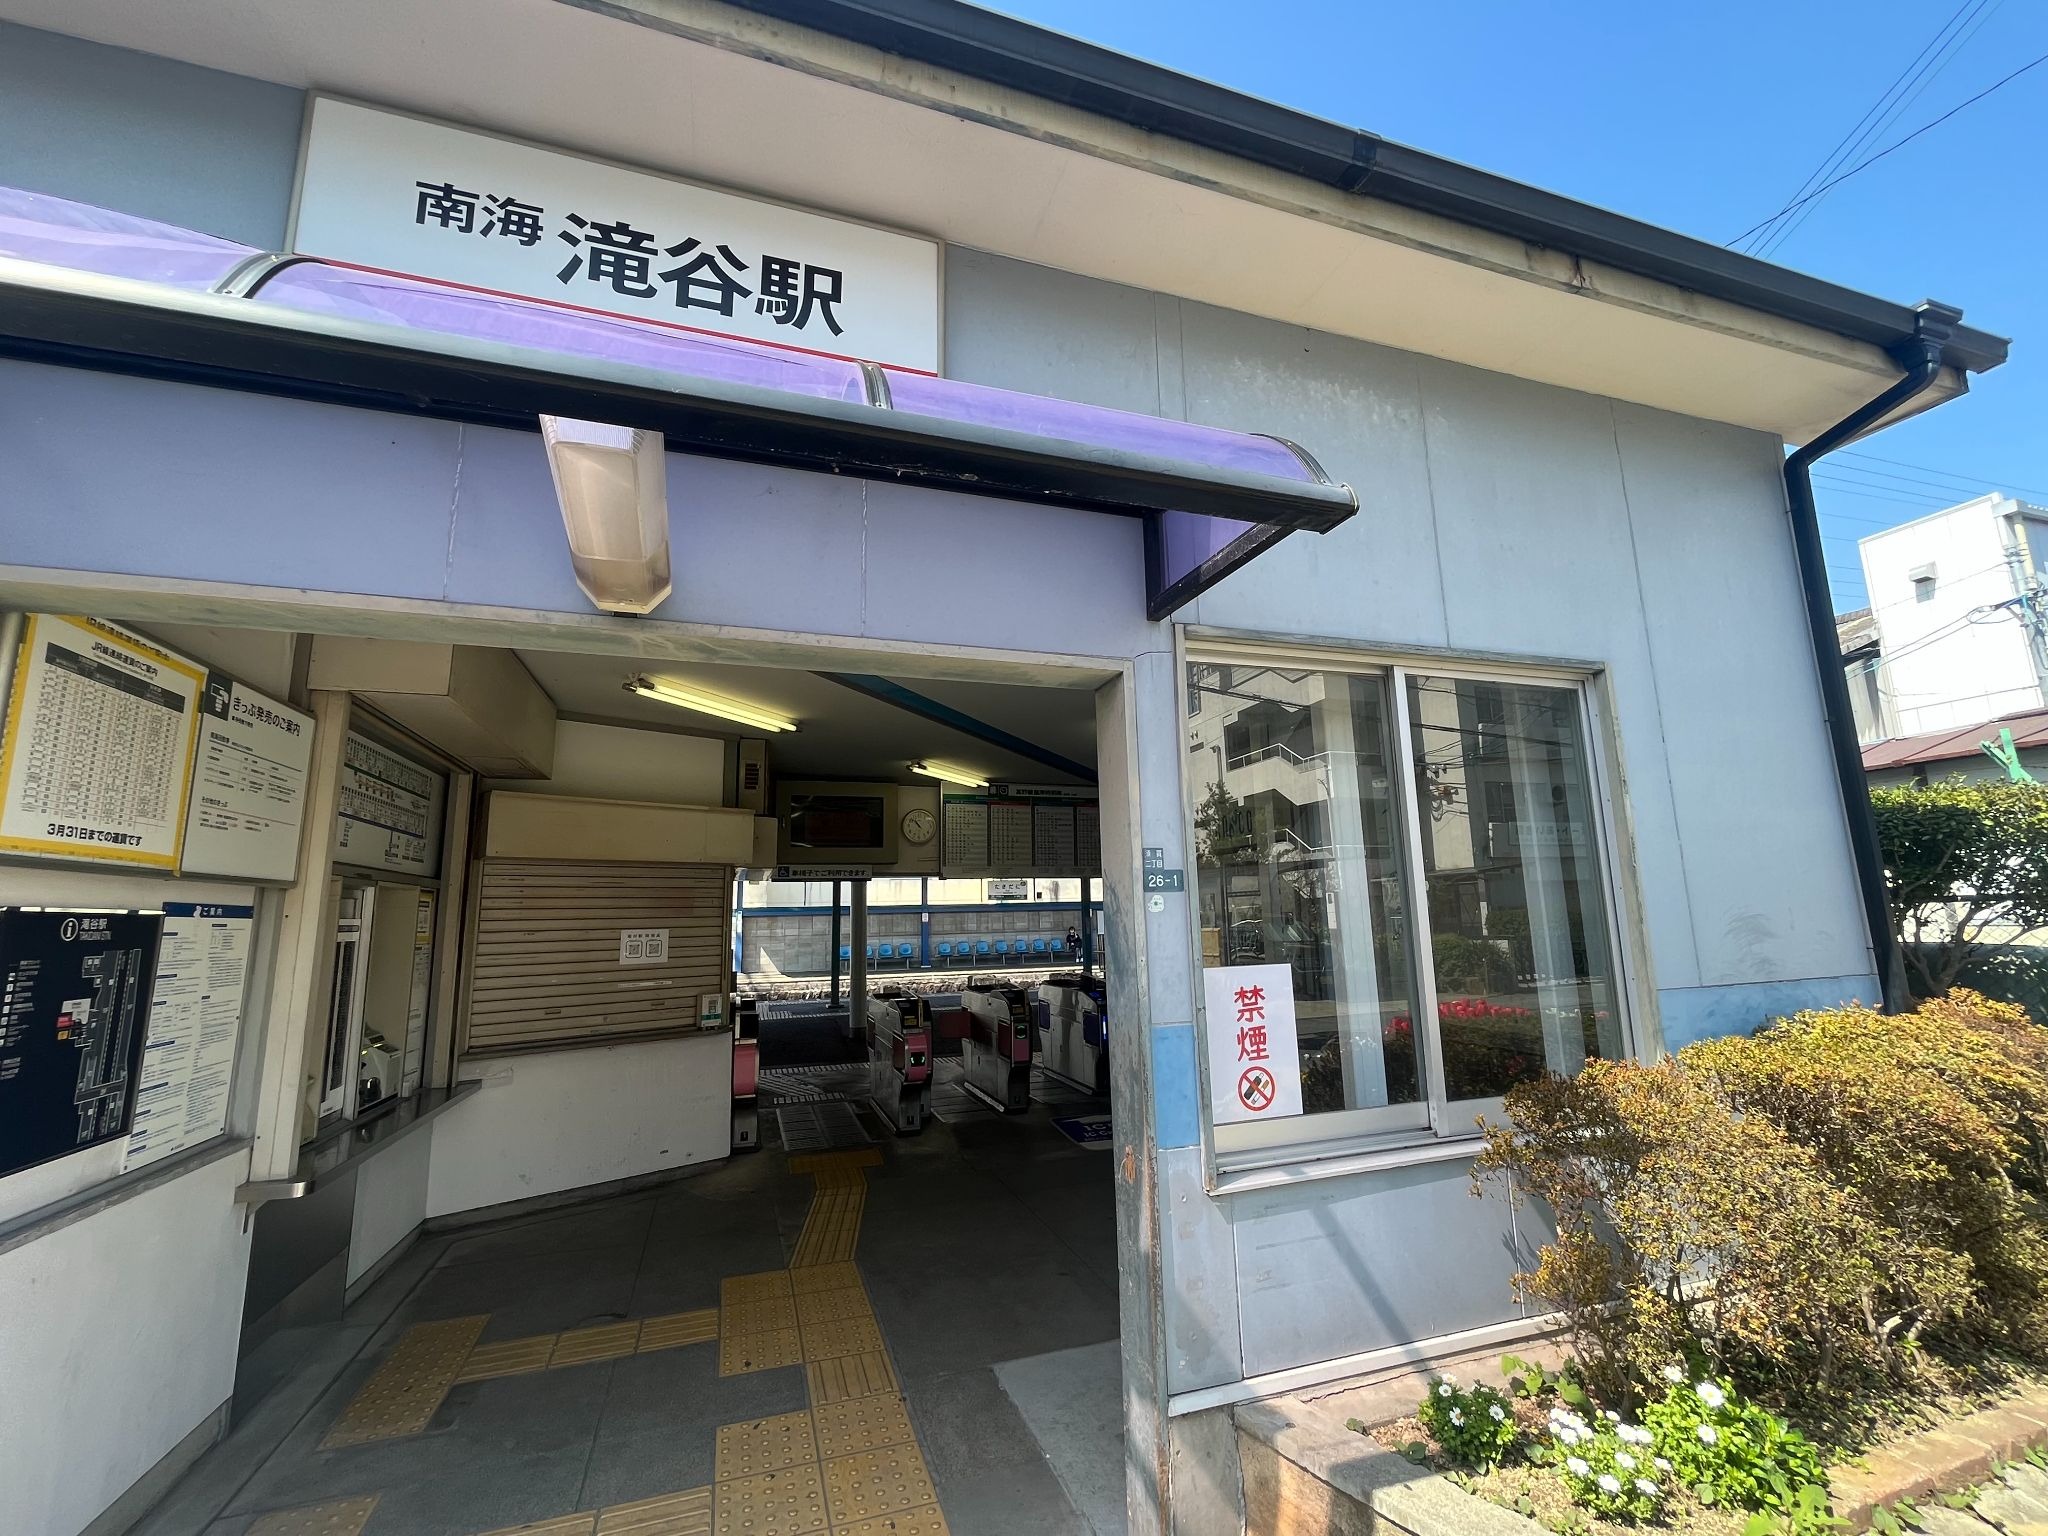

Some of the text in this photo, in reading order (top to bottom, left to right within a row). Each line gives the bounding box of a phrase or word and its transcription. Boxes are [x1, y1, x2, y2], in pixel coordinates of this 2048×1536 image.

[415, 180, 845, 337] 南海 滝谷駅
[233, 697, 301, 736] きっぷ発売のご案内
[46, 823, 143, 847] 3月31日までの運賃です
[1145, 859, 1163, 868] 二丁目
[1148, 874, 1178, 887] 26-1
[1233, 984, 1270, 1062] 禁煙
